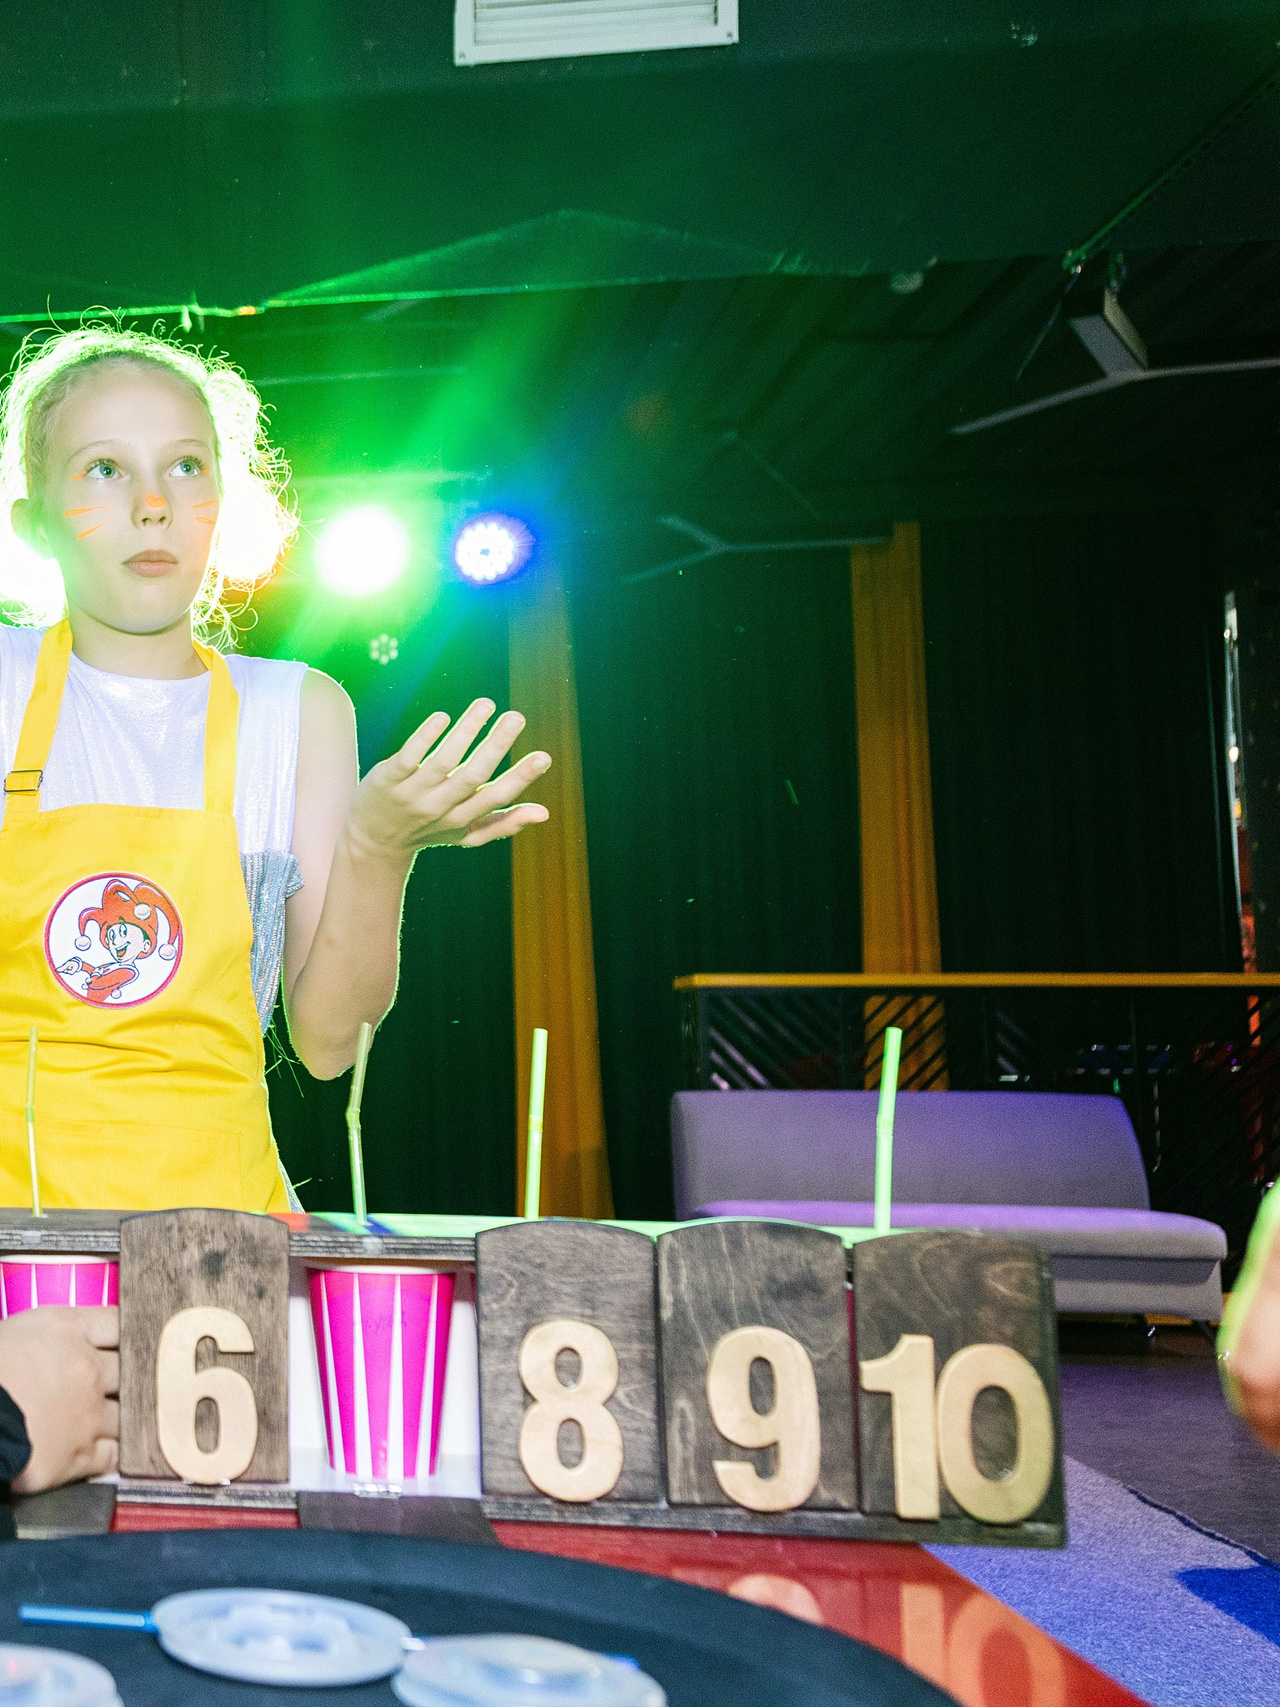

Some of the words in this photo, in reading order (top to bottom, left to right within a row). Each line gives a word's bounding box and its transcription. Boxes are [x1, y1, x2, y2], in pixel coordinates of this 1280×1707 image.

[156, 1305, 258, 1486] 6
[518, 1319, 624, 1503] 8
[706, 1325, 821, 1513] 9
[858, 1333, 1055, 1525] 10
